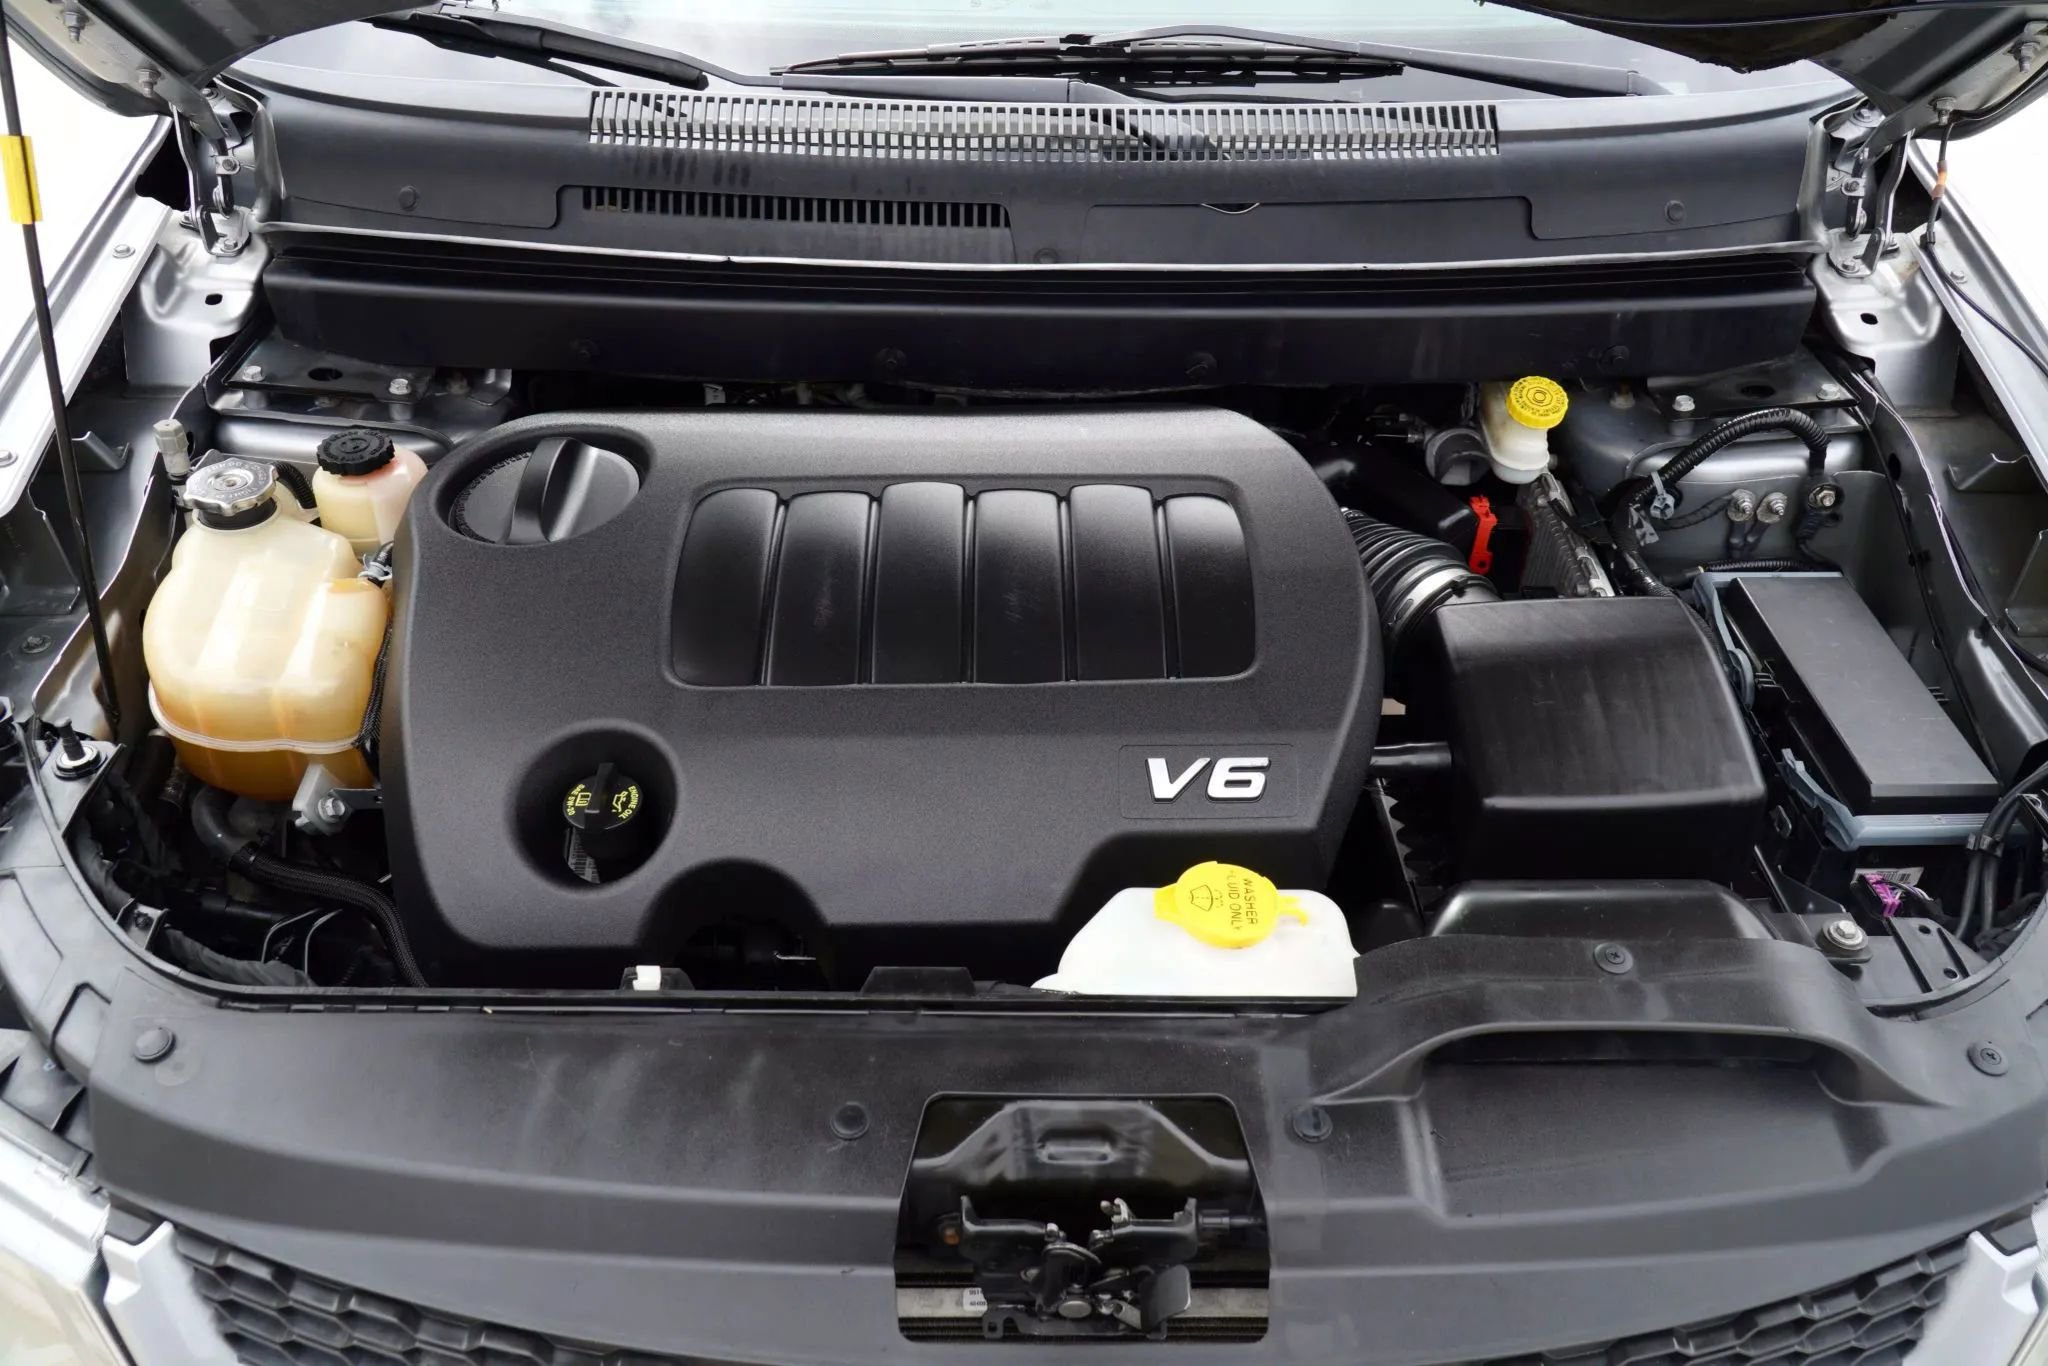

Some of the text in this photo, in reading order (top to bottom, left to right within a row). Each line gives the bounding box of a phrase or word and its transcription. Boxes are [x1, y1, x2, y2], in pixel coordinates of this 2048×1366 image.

[1147, 757, 1270, 801] V6
[618, 785, 639, 819] ENGINE OIL
[1243, 878, 1258, 925] WASHER
